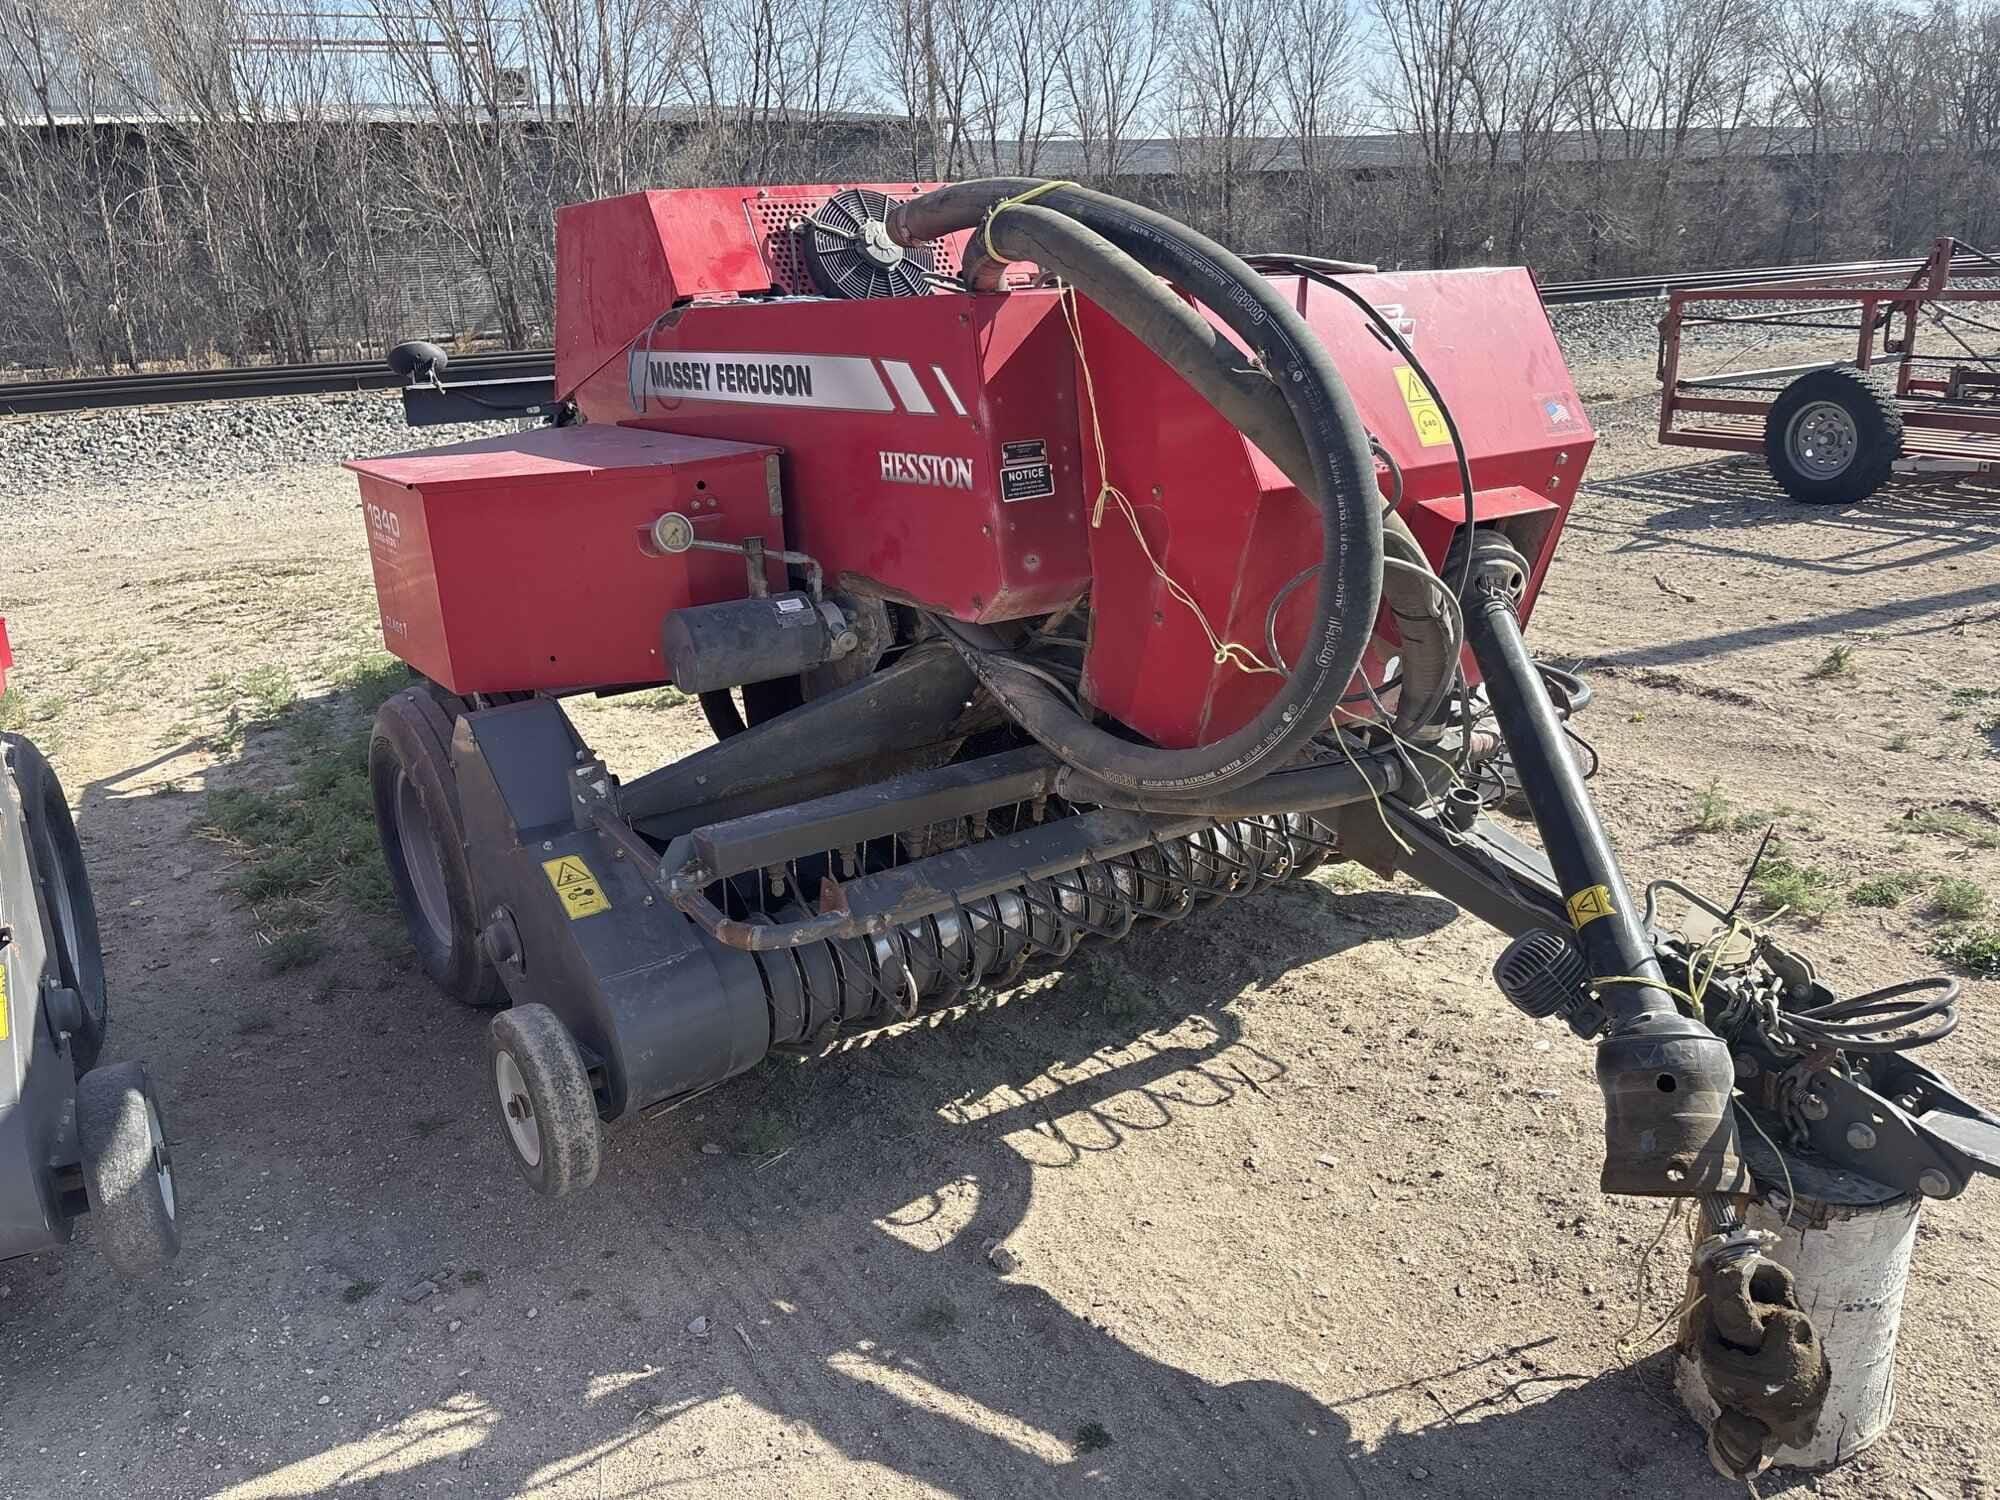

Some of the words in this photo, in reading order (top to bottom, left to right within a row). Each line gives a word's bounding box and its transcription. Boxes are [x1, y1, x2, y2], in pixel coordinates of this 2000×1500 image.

[1230, 282, 1268, 326] Goodall
[650, 361, 710, 391] MASSEY
[715, 363, 813, 397] FERGUSON
[879, 451, 974, 491] HESSTON
[1008, 467, 1045, 482] NOTICE
[367, 502, 400, 538] 1840
[1219, 759, 1242, 775] WATER
